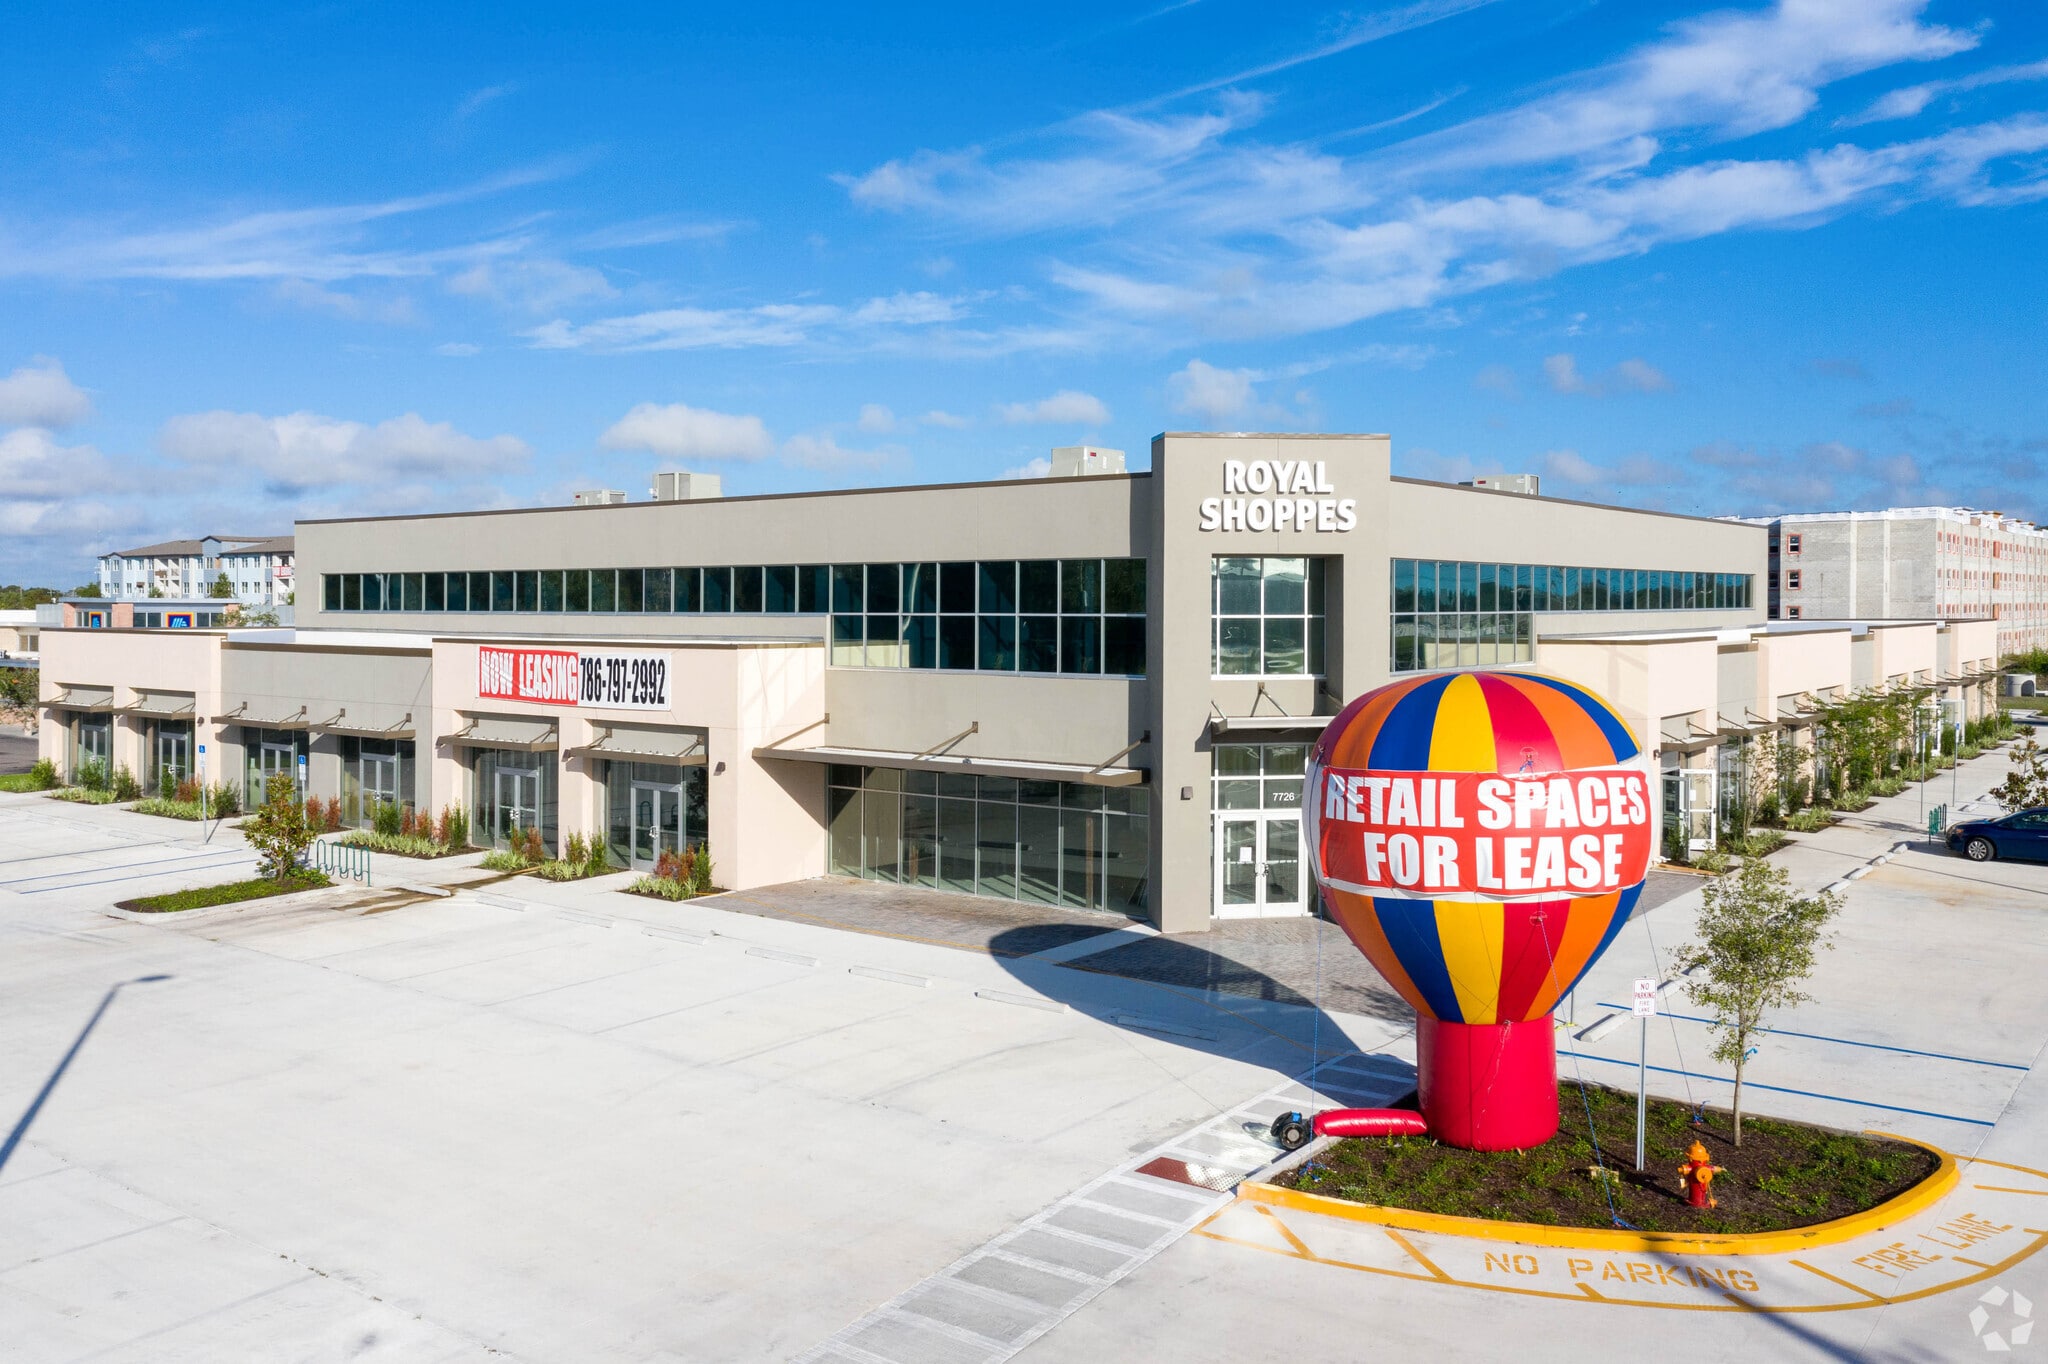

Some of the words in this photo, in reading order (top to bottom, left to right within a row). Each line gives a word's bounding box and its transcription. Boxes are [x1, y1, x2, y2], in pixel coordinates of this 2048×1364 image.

[1223, 460, 1334, 494] ROYAL
[1199, 497, 1357, 532] SHOPPES
[480, 650, 514, 695] NOW
[519, 654, 578, 701] LEASING
[580, 657, 666, 704] 786-797-2992
[1272, 792, 1295, 801] 7726
[1325, 774, 1464, 829] RETAIL
[1477, 776, 1646, 830] SPACES
[1363, 832, 1460, 887] FOR
[1475, 833, 1623, 890] LEASE
[1640, 982, 1650, 991] NO
[1851, 1242, 1943, 1278] FIRE
[1917, 1212, 2014, 1250] LANE
[1484, 1252, 1540, 1275] NO
[1567, 1257, 1760, 1291] PARKING
